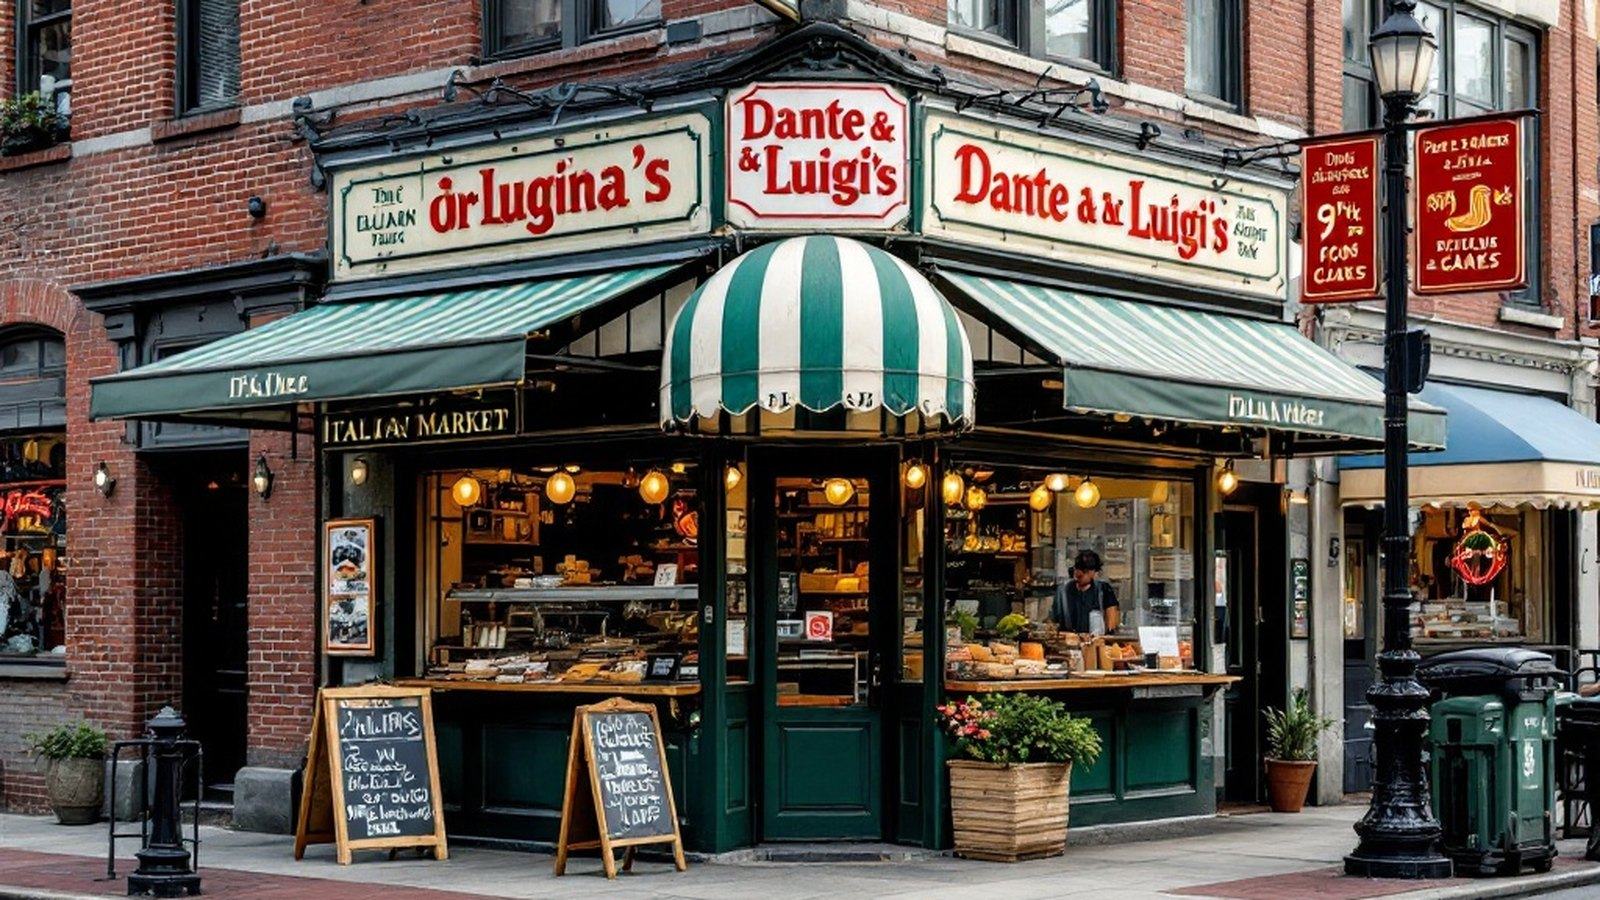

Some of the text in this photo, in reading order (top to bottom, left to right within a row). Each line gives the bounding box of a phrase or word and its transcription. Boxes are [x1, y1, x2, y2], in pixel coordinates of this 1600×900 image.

[741, 99, 896, 142] Dante &
[738, 145, 897, 206] & Luigi's
[953, 144, 1069, 222] Dante
[417, 408, 508, 437] MARKET
